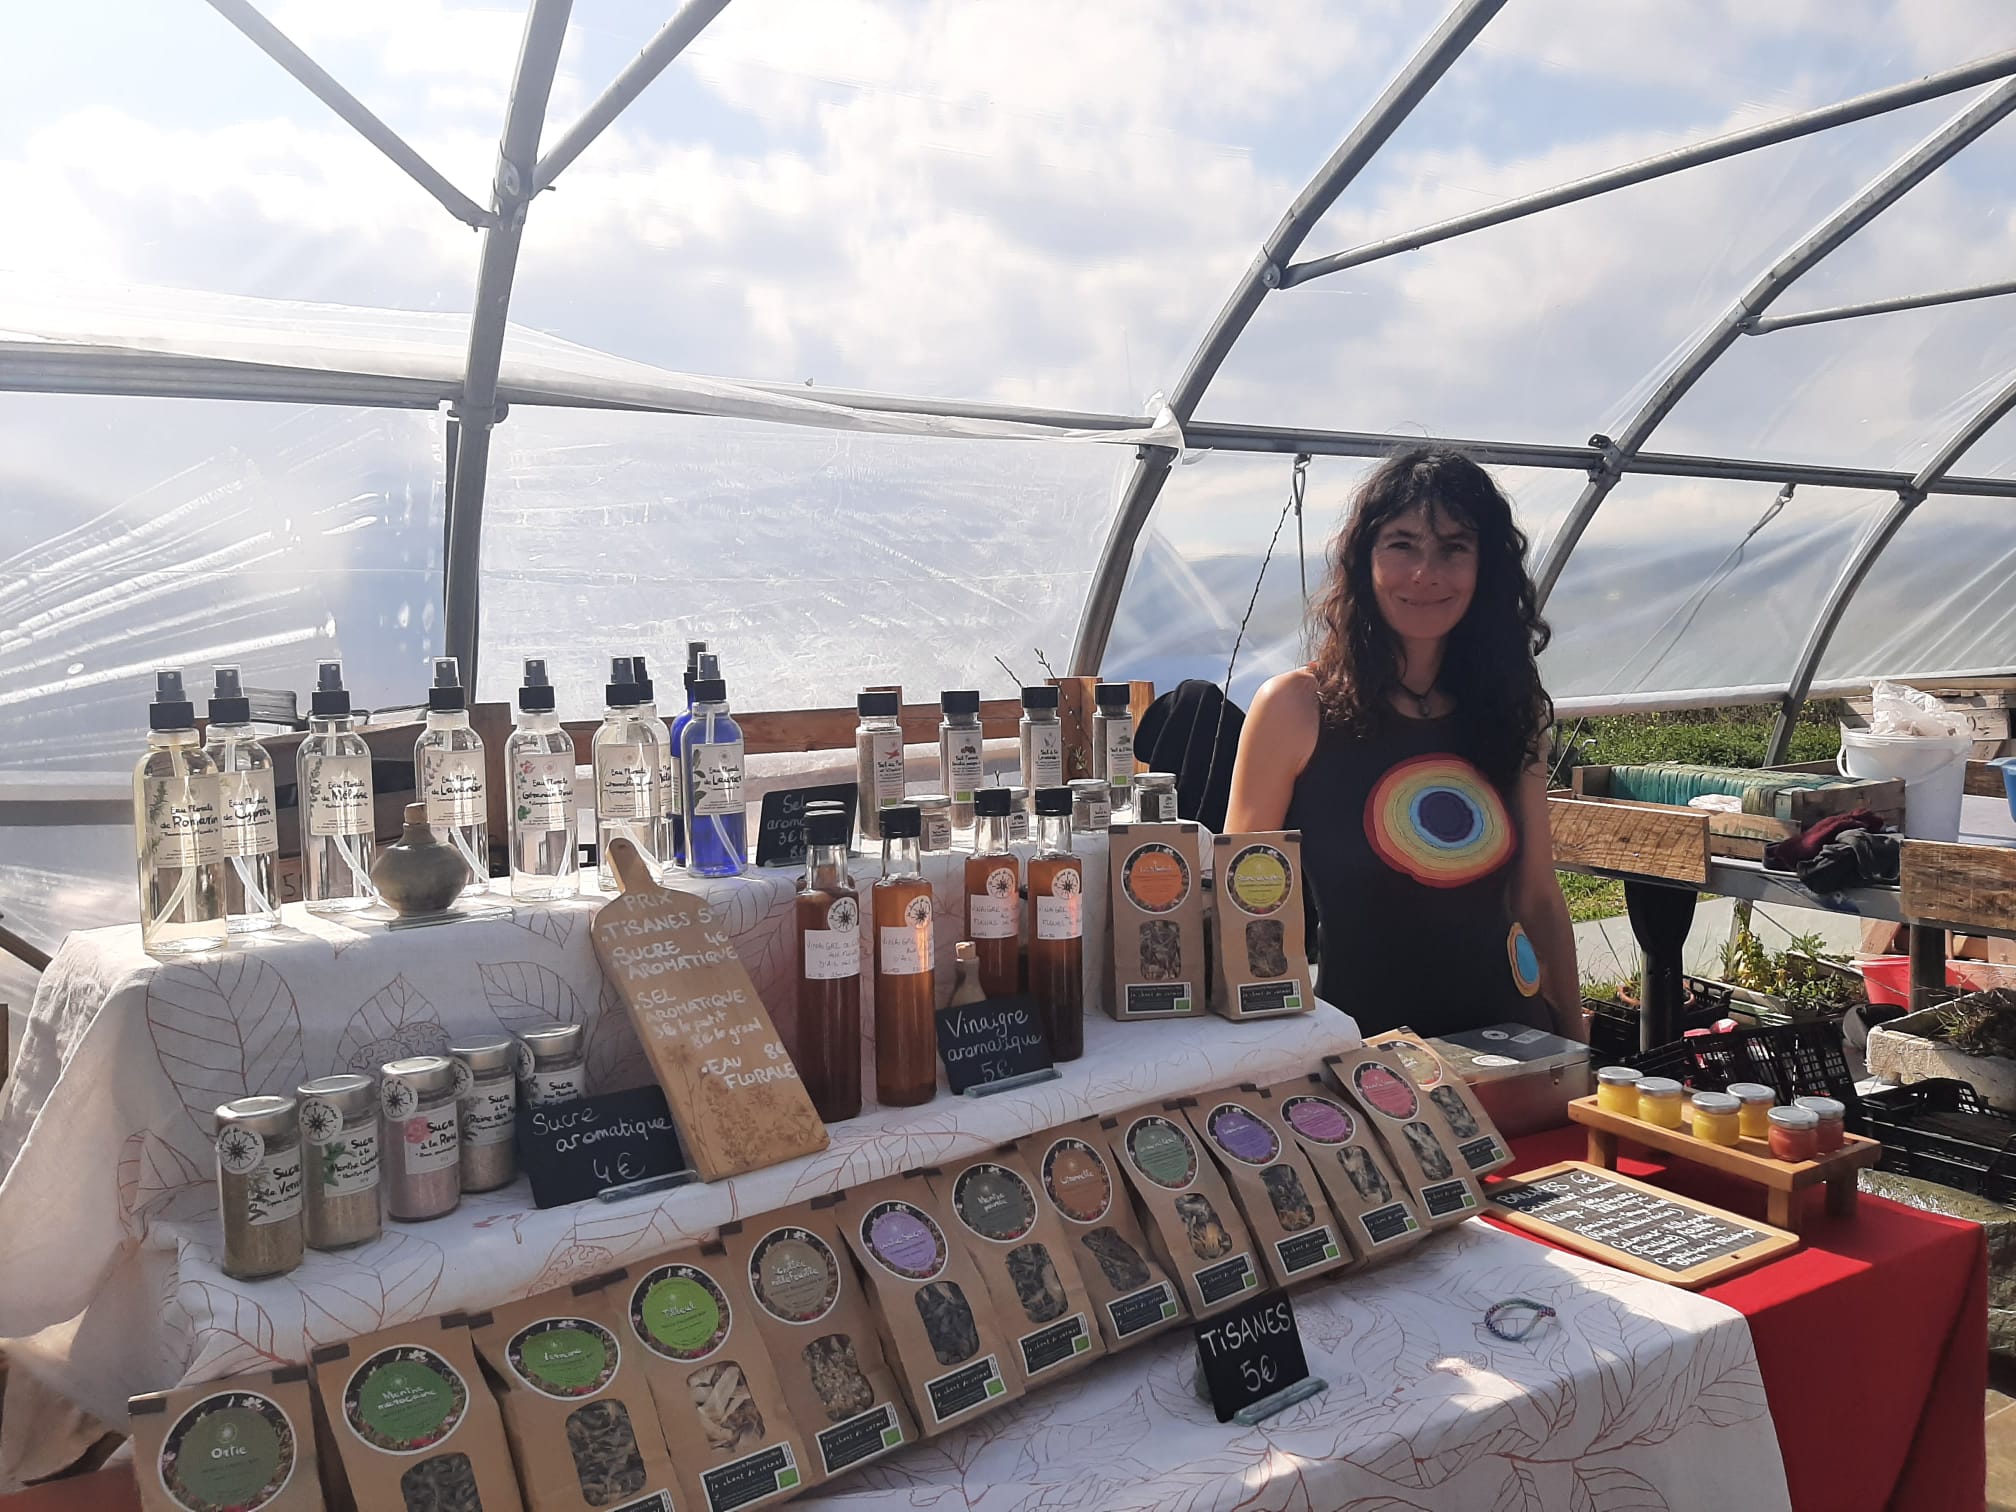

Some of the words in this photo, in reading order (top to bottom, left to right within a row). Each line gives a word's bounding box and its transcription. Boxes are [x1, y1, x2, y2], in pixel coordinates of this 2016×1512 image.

[782, 793, 806, 814] Sel
[612, 940, 681, 965] SUCRE
[638, 988, 677, 1009] SEL
[729, 1017, 763, 1045] grand
[945, 1009, 1029, 1039] Vinaigre
[947, 1034, 1042, 1062] aromatique
[706, 1056, 742, 1075] EAU
[724, 1062, 799, 1089] FLORALE
[427, 1119, 454, 1133] Sucre
[533, 1108, 600, 1136] Sucre
[351, 1137, 374, 1149] Sucre
[556, 1117, 673, 1153] aromatique
[378, 1391, 437, 1409] marocaine
[382, 1386, 424, 1400] Menthe
[211, 1446, 247, 1458] Ortie
